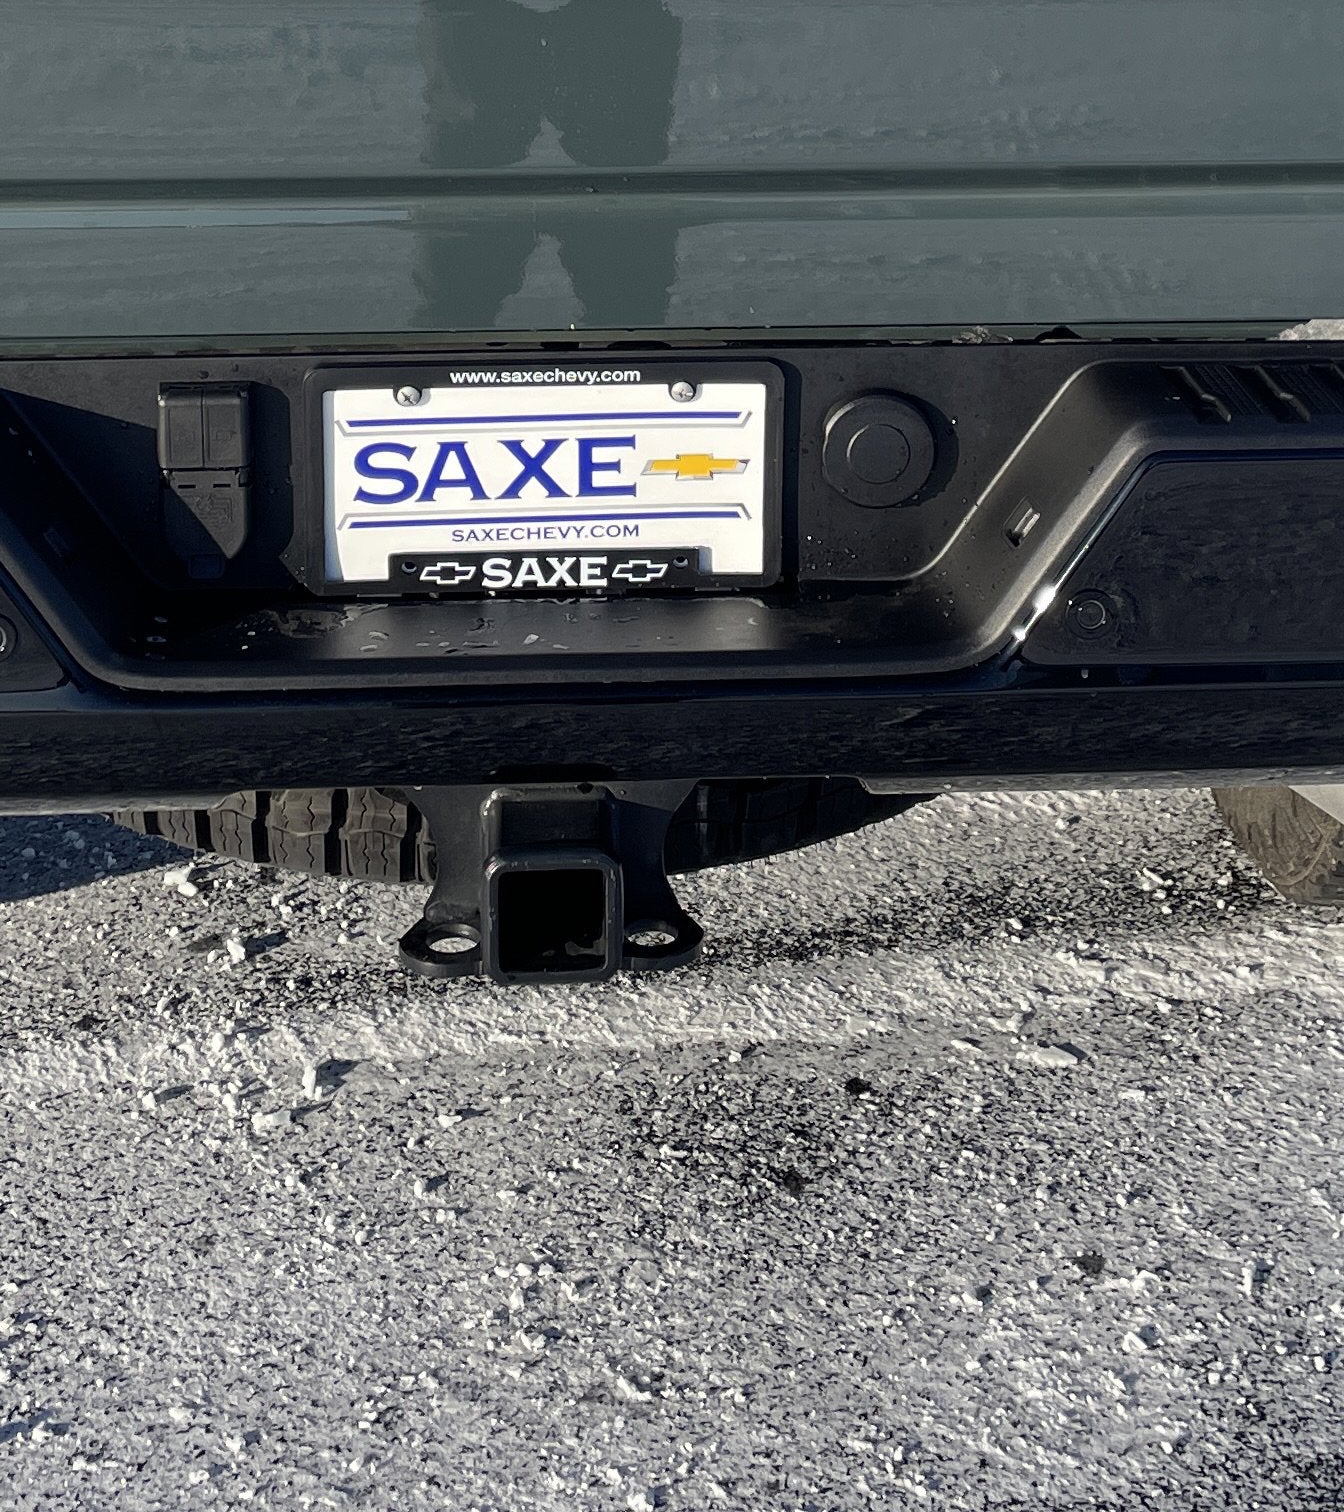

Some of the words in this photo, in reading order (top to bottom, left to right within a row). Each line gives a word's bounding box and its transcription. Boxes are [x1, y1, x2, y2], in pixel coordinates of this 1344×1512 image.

[449, 368, 641, 385] www.saxechevy.com
[353, 435, 638, 504] SAXE
[451, 524, 640, 543] SAXECHEVY.COM
[481, 556, 608, 588] SAXE
